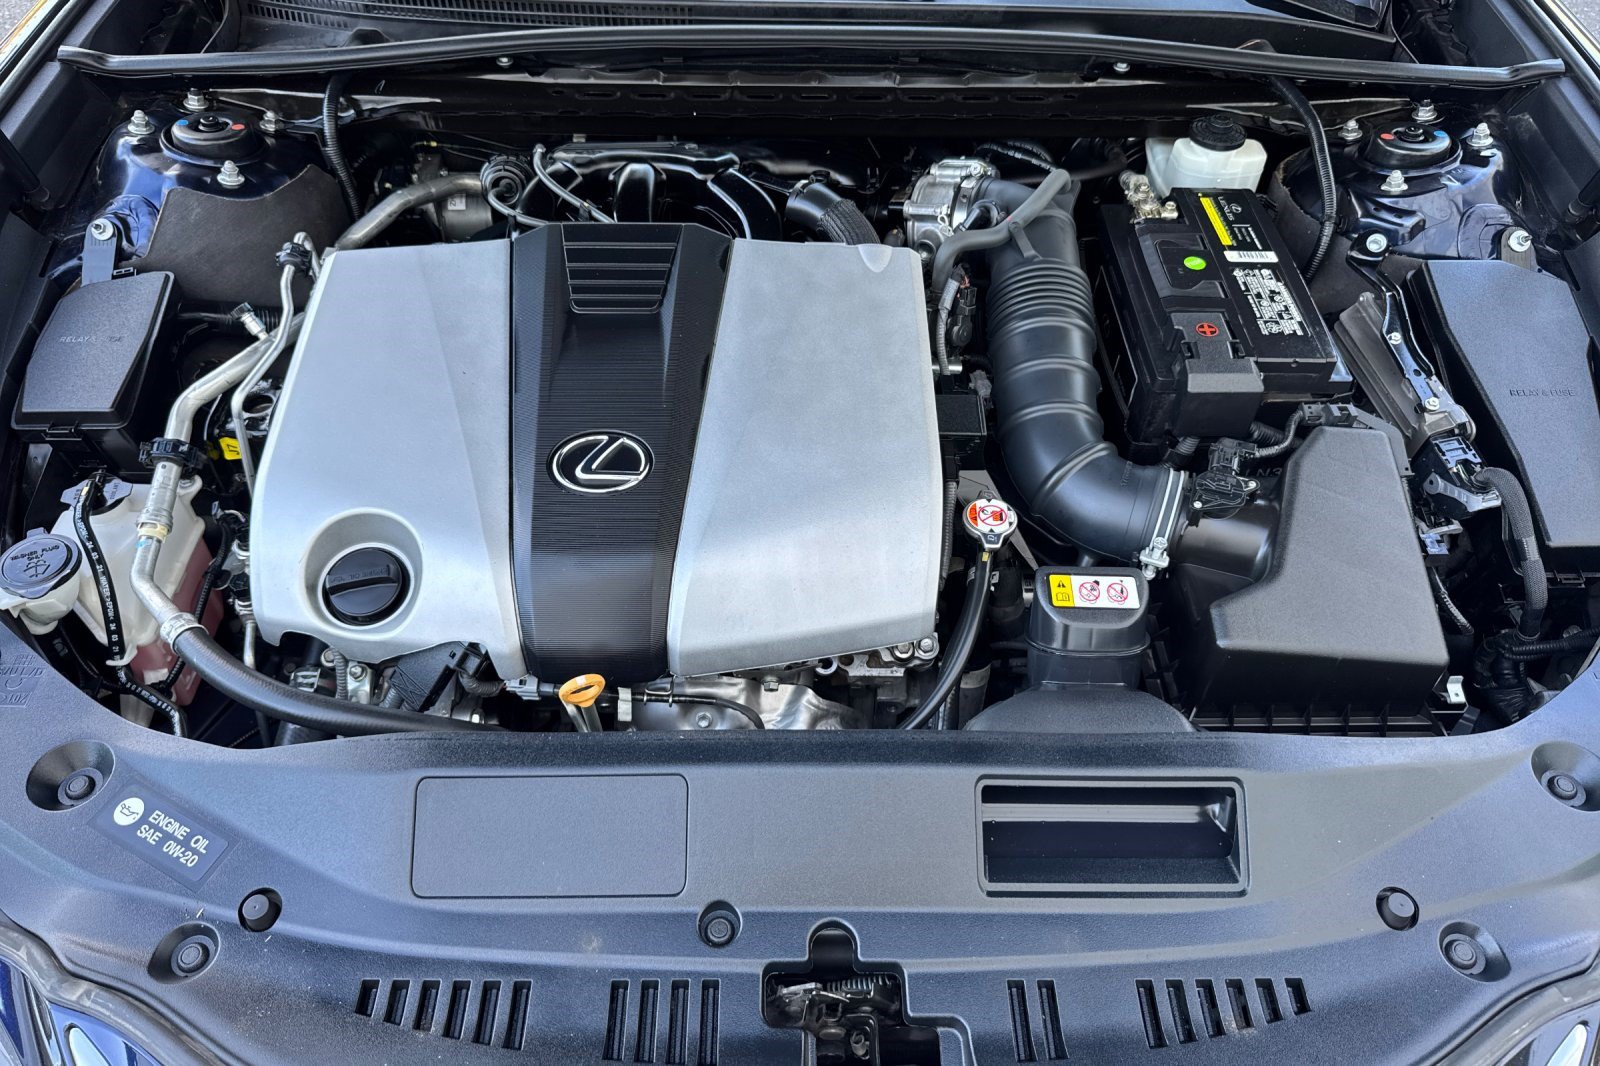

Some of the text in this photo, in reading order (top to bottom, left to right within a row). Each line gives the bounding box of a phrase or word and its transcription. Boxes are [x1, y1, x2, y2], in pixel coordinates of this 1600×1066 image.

[1217, 196, 1235, 220] LEXUS
[1509, 388, 1539, 396] RELAY
[1550, 388, 1575, 396] FUSE
[136, 824, 199, 867] SAE 0W-20
[149, 810, 209, 854] ENGINE OIL
